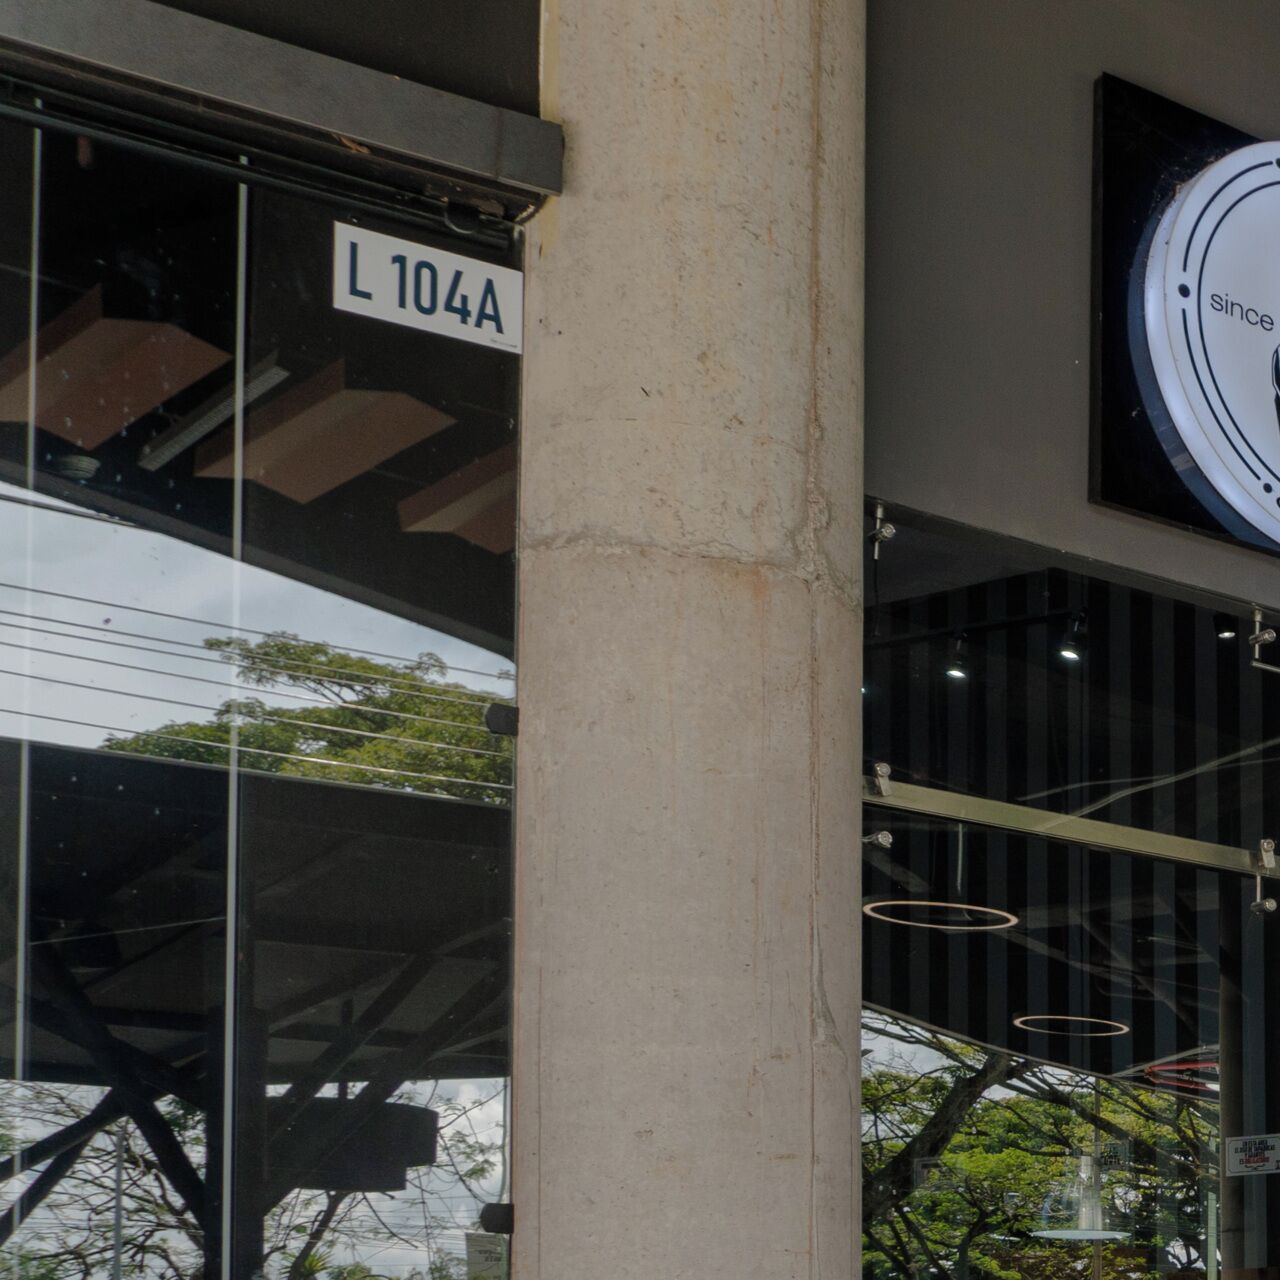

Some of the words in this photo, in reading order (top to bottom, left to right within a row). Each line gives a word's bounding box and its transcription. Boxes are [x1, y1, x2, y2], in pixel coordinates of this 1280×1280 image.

[349, 241, 373, 301] L
[391, 254, 504, 335] 104A
[1209, 290, 1275, 333] since
